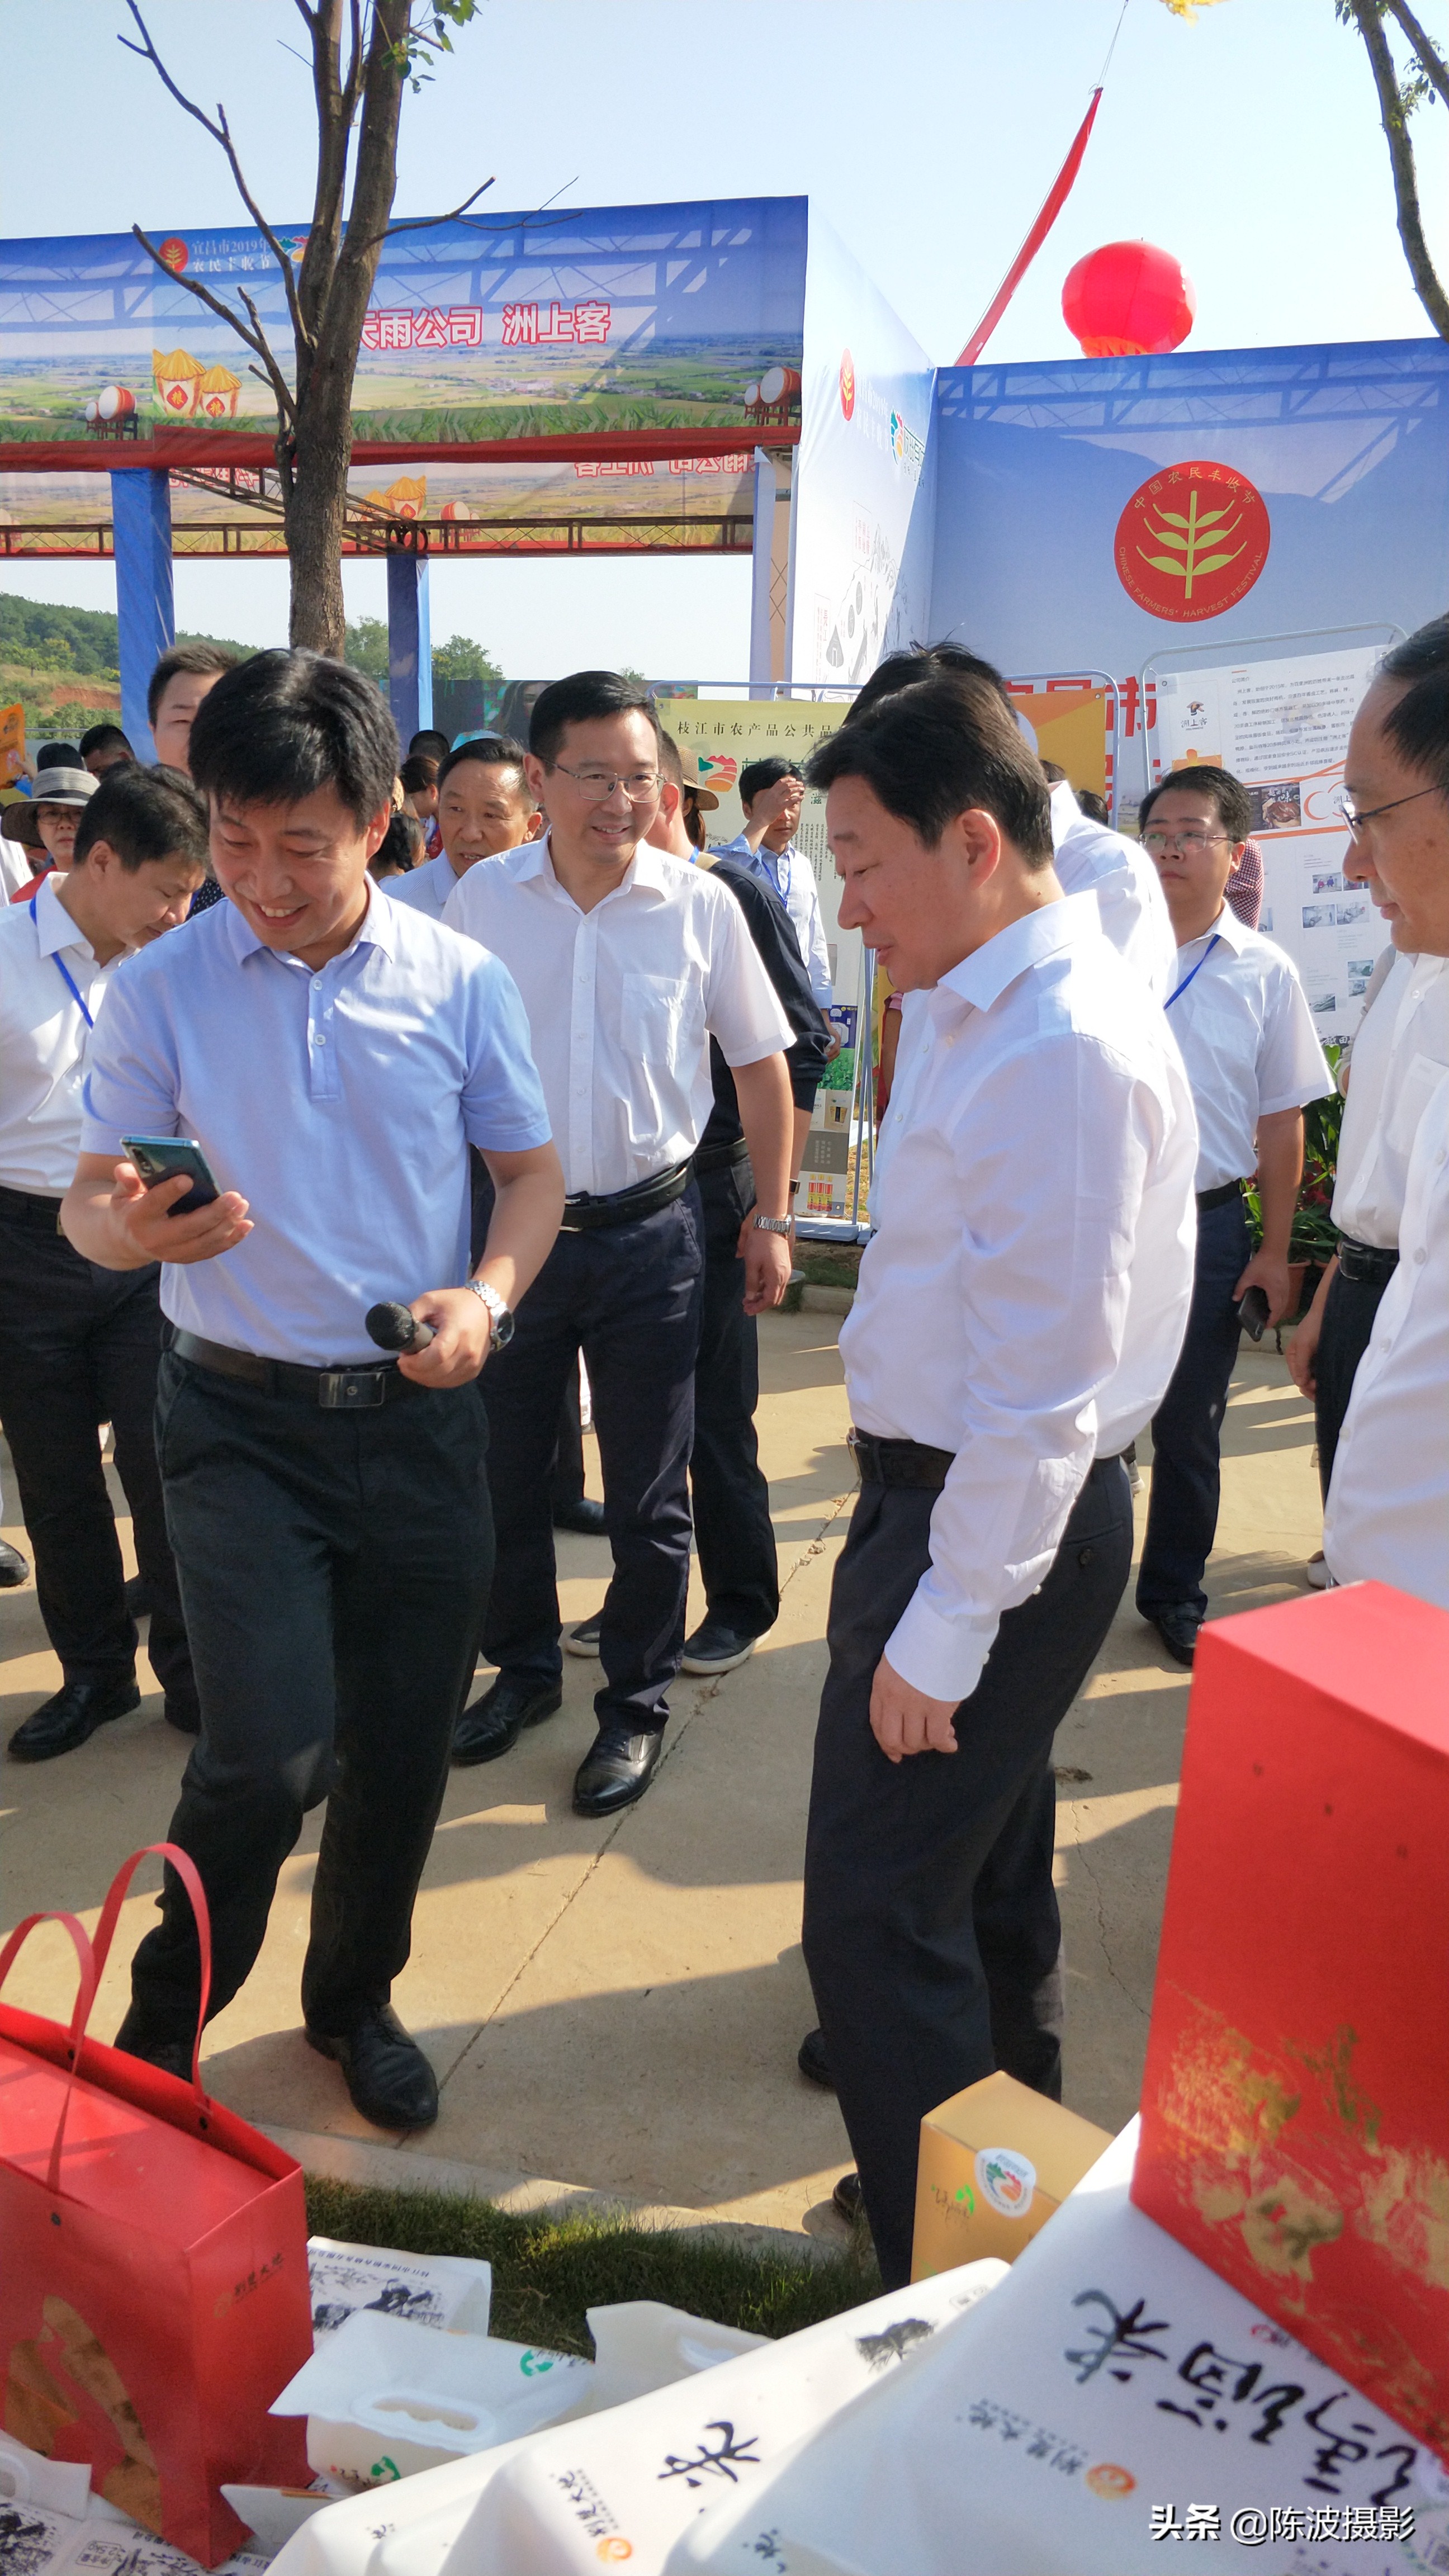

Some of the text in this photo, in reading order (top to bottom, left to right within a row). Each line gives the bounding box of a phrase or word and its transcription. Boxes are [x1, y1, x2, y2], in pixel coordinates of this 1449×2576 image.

[502, 300, 612, 345] 洲上客
[1134, 467, 1256, 509] 中国农民丰收节
[1119, 546, 1135, 588] CHINESE
[1182, 596, 1229, 618] HARVEST
[1230, 551, 1263, 598] FESTIVAL
